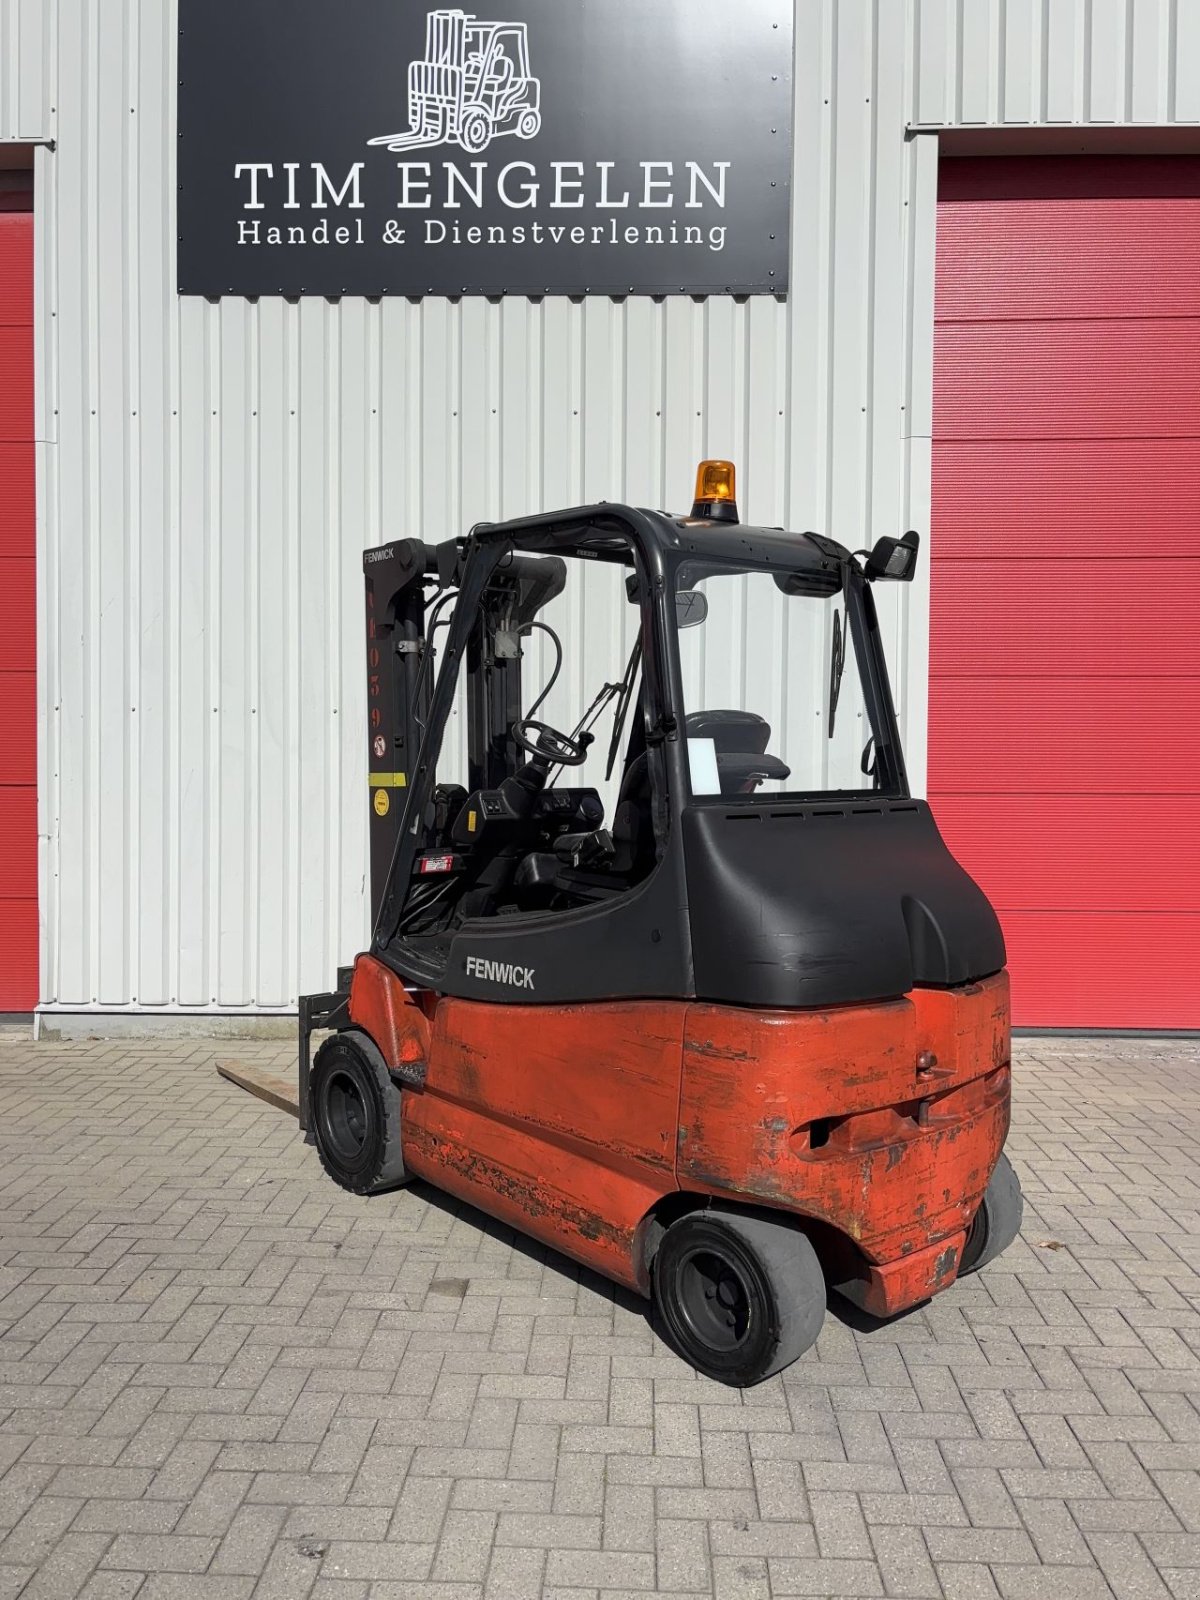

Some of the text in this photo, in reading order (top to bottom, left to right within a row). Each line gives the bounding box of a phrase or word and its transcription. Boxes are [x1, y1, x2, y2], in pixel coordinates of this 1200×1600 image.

[235, 162, 731, 208] TIM ENGELEN
[238, 219, 726, 250] Handel & Dienstverlening
[364, 548, 394, 564] FENWICK
[466, 956, 535, 990] FENWICK
